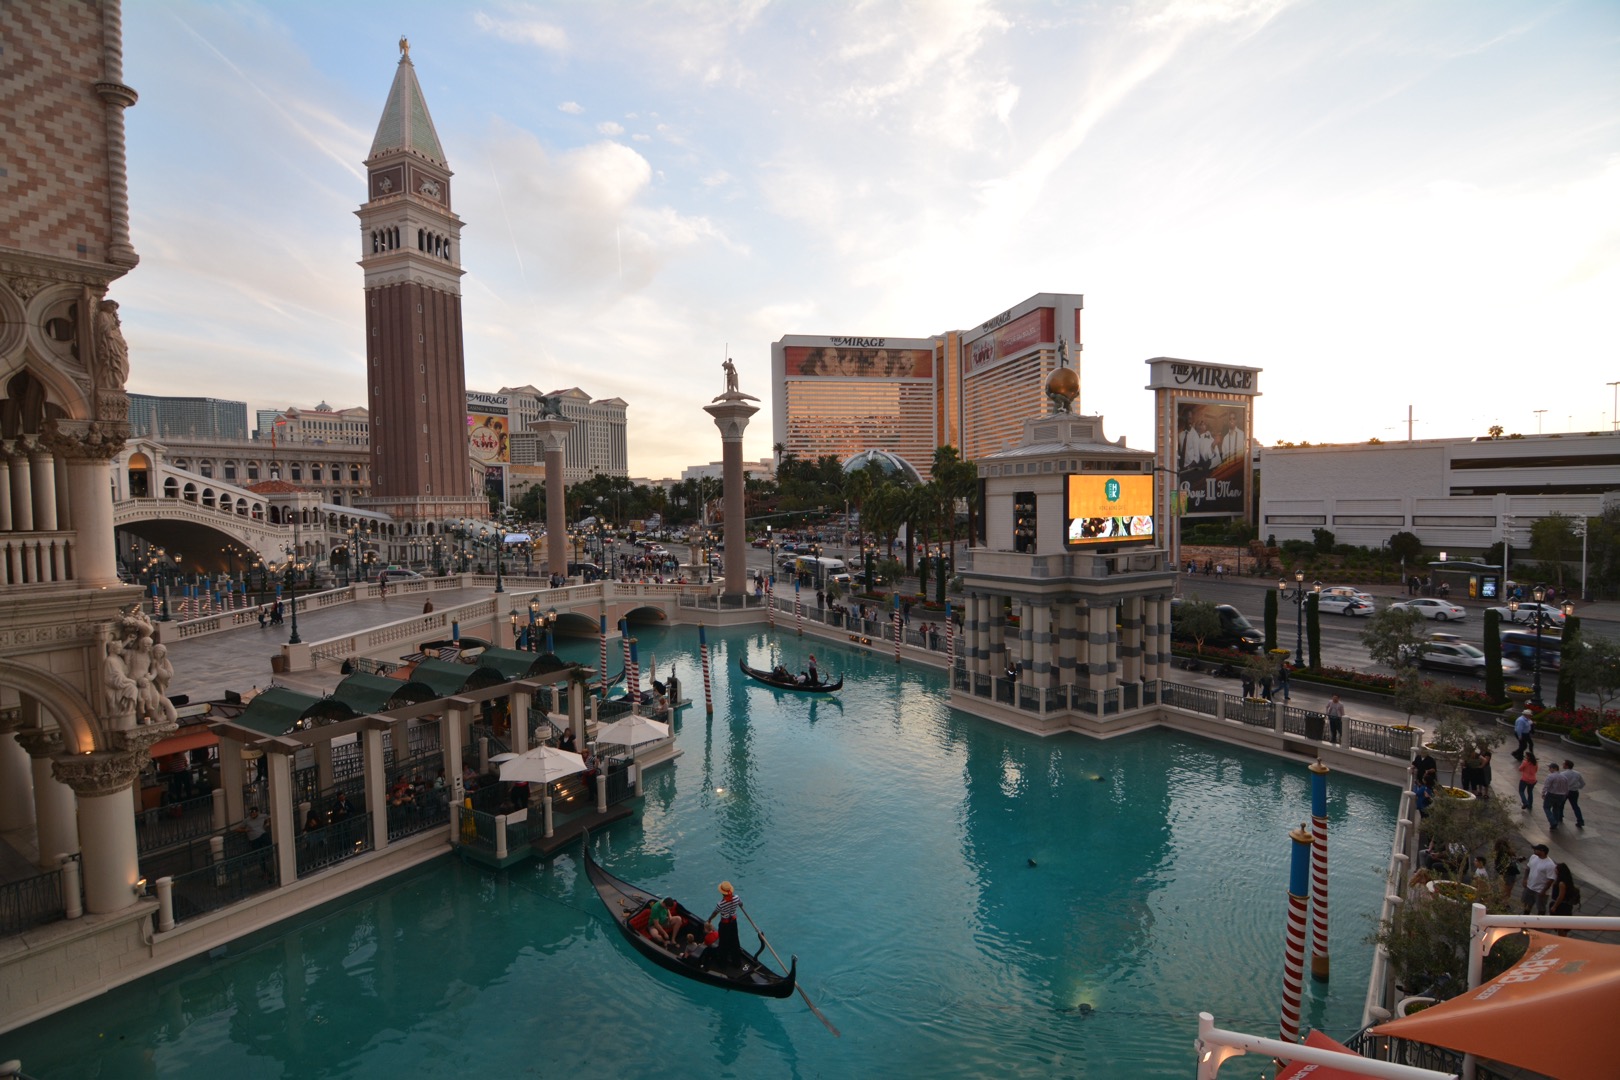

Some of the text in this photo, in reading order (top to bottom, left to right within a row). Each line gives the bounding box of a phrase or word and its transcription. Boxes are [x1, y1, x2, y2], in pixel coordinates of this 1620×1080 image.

[985, 310, 1011, 331] MIRAGE
[833, 337, 885, 348] MIRAGE
[1170, 363, 1252, 390] THE MIRAGE
[467, 394, 508, 405] MIRAGE
[1205, 478, 1217, 500] II
[1217, 480, 1242, 498] Men
